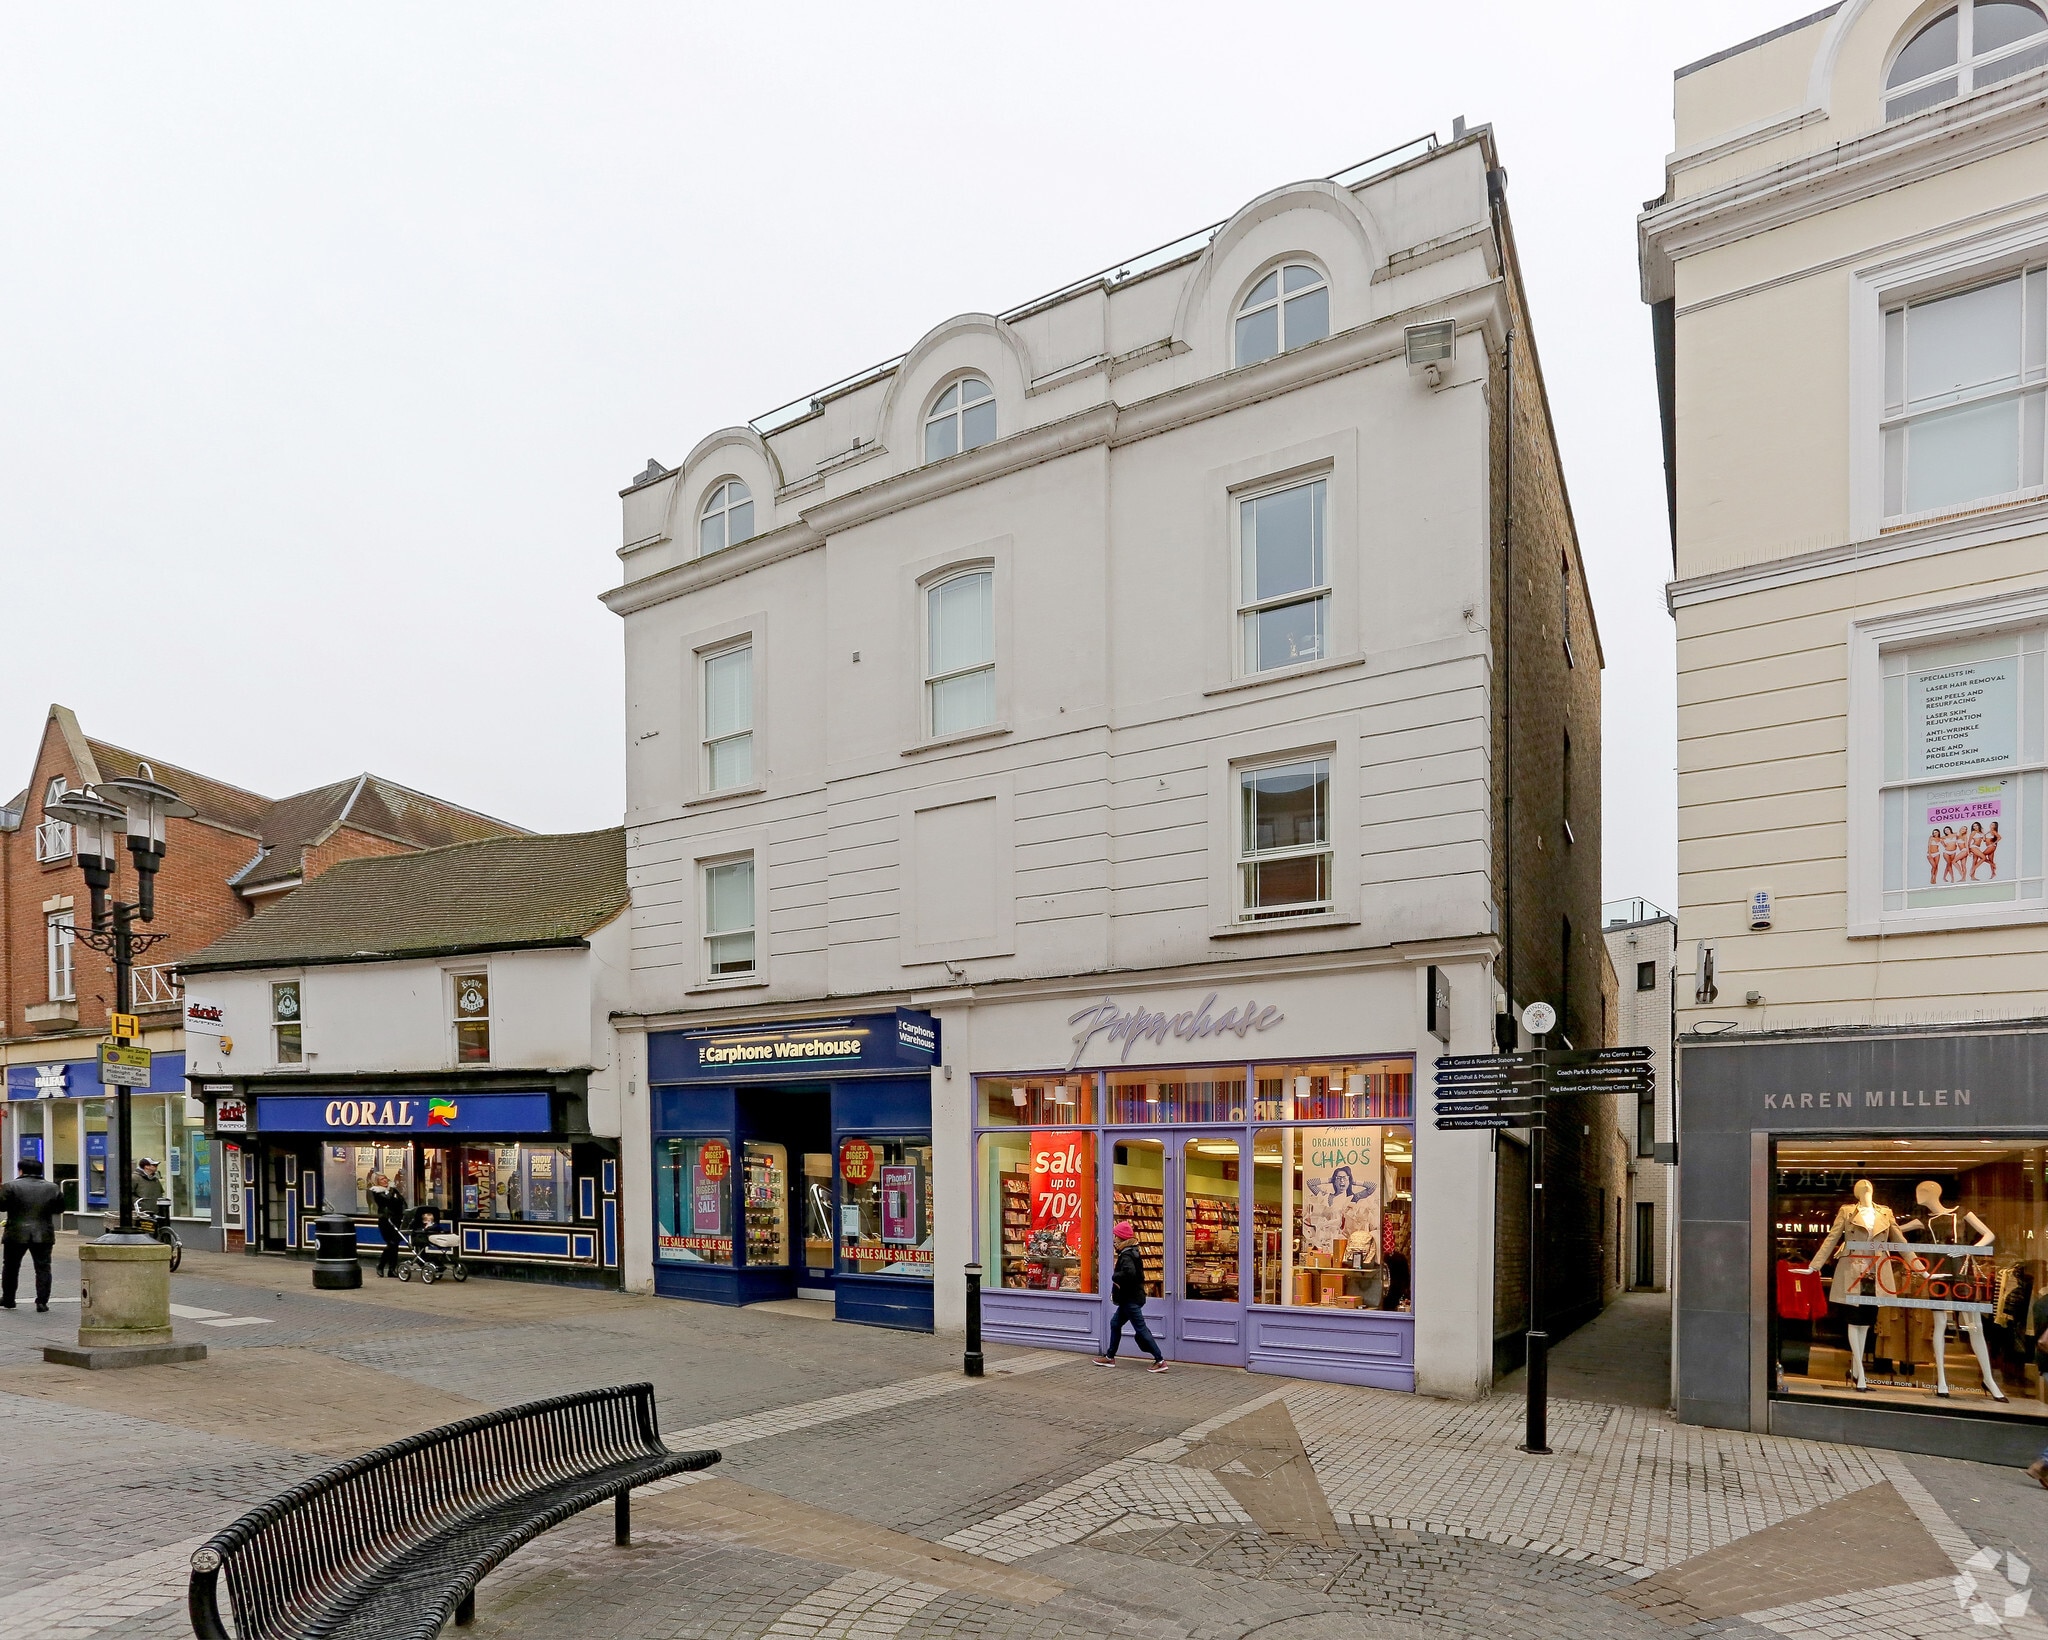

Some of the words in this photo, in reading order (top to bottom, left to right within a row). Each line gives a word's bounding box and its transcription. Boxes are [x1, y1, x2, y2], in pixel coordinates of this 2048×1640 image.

[1920, 670, 1964, 682] SPECIALISTS
[1926, 684, 1948, 692] LASER
[1969, 675, 2006, 685] REMOVAL
[1944, 692, 1966, 700] PEELS
[1926, 696, 1976, 709] RESURFACING
[1926, 712, 1948, 720] LASER
[1926, 713, 1982, 726] REJUVENATION
[1926, 724, 1980, 736] ANTI-WRINKLE
[1926, 732, 1968, 742] INJECTIONS
[1926, 751, 1960, 760] PROBLEM
[1926, 754, 2010, 770] MICRODERMABRASION
[1936, 806, 1960, 815] BOOK
[1972, 802, 1993, 810] FREE
[1930, 809, 1998, 822] CONSULTATION
[1526, 1004, 1552, 1015] WINDSOR
[116, 1016, 134, 1036] H
[187, 1018, 224, 1028] TATTOO
[902, 1022, 935, 1038] Carphone
[1064, 992, 1284, 1072] Paperchase
[899, 1032, 935, 1049] Warehouse
[706, 1044, 772, 1064] Carphone
[774, 1039, 860, 1058] Warehouse
[36, 1076, 66, 1088] HALIFAX
[1592, 1084, 1612, 1092] Shopping
[1764, 1091, 1852, 1109] KAREN
[1865, 1089, 1971, 1107] MILLEN
[325, 1100, 414, 1126] CORAL
[1312, 1137, 1348, 1148] ORGANISE
[1350, 1136, 1371, 1147] YOUR
[358, 1154, 374, 1163] PRICE
[386, 1156, 402, 1164] PRICE
[532, 1156, 552, 1164] SHOW
[704, 1151, 725, 1159] BIGGEST
[846, 1152, 869, 1160] BIGGEST
[1312, 1148, 1371, 1168] CHAOS
[498, 1158, 516, 1166] PRICE
[532, 1164, 552, 1172] PRICE
[706, 1164, 723, 1176] SALE
[846, 1166, 867, 1178] SALE
[230, 1152, 240, 1213] TATTOO
[886, 1174, 906, 1184] iPhone
[908, 1172, 912, 1180] 7
[1050, 1178, 1063, 1190] up
[1066, 1178, 1076, 1188] to
[696, 1184, 717, 1194] BIGGEST
[698, 1201, 716, 1213] SALE
[1038, 1192, 1082, 1218] 70%
[671, 1237, 684, 1248] SALE
[686, 1238, 700, 1248] SALE
[702, 1239, 716, 1250] SALE
[718, 1240, 733, 1250] SALE
[1870, 1242, 1899, 1250] SALE
[856, 1247, 874, 1259] SALE
[874, 1248, 893, 1260] SALE
[894, 1250, 913, 1262] SALE
[916, 1252, 934, 1262] SALE
[1852, 1296, 1888, 1306] FINAL
[1898, 1299, 1986, 1312] REDUCTIONS
[1864, 1377, 1892, 1386] Discover
[1922, 1382, 1982, 1393] kareillen.com
